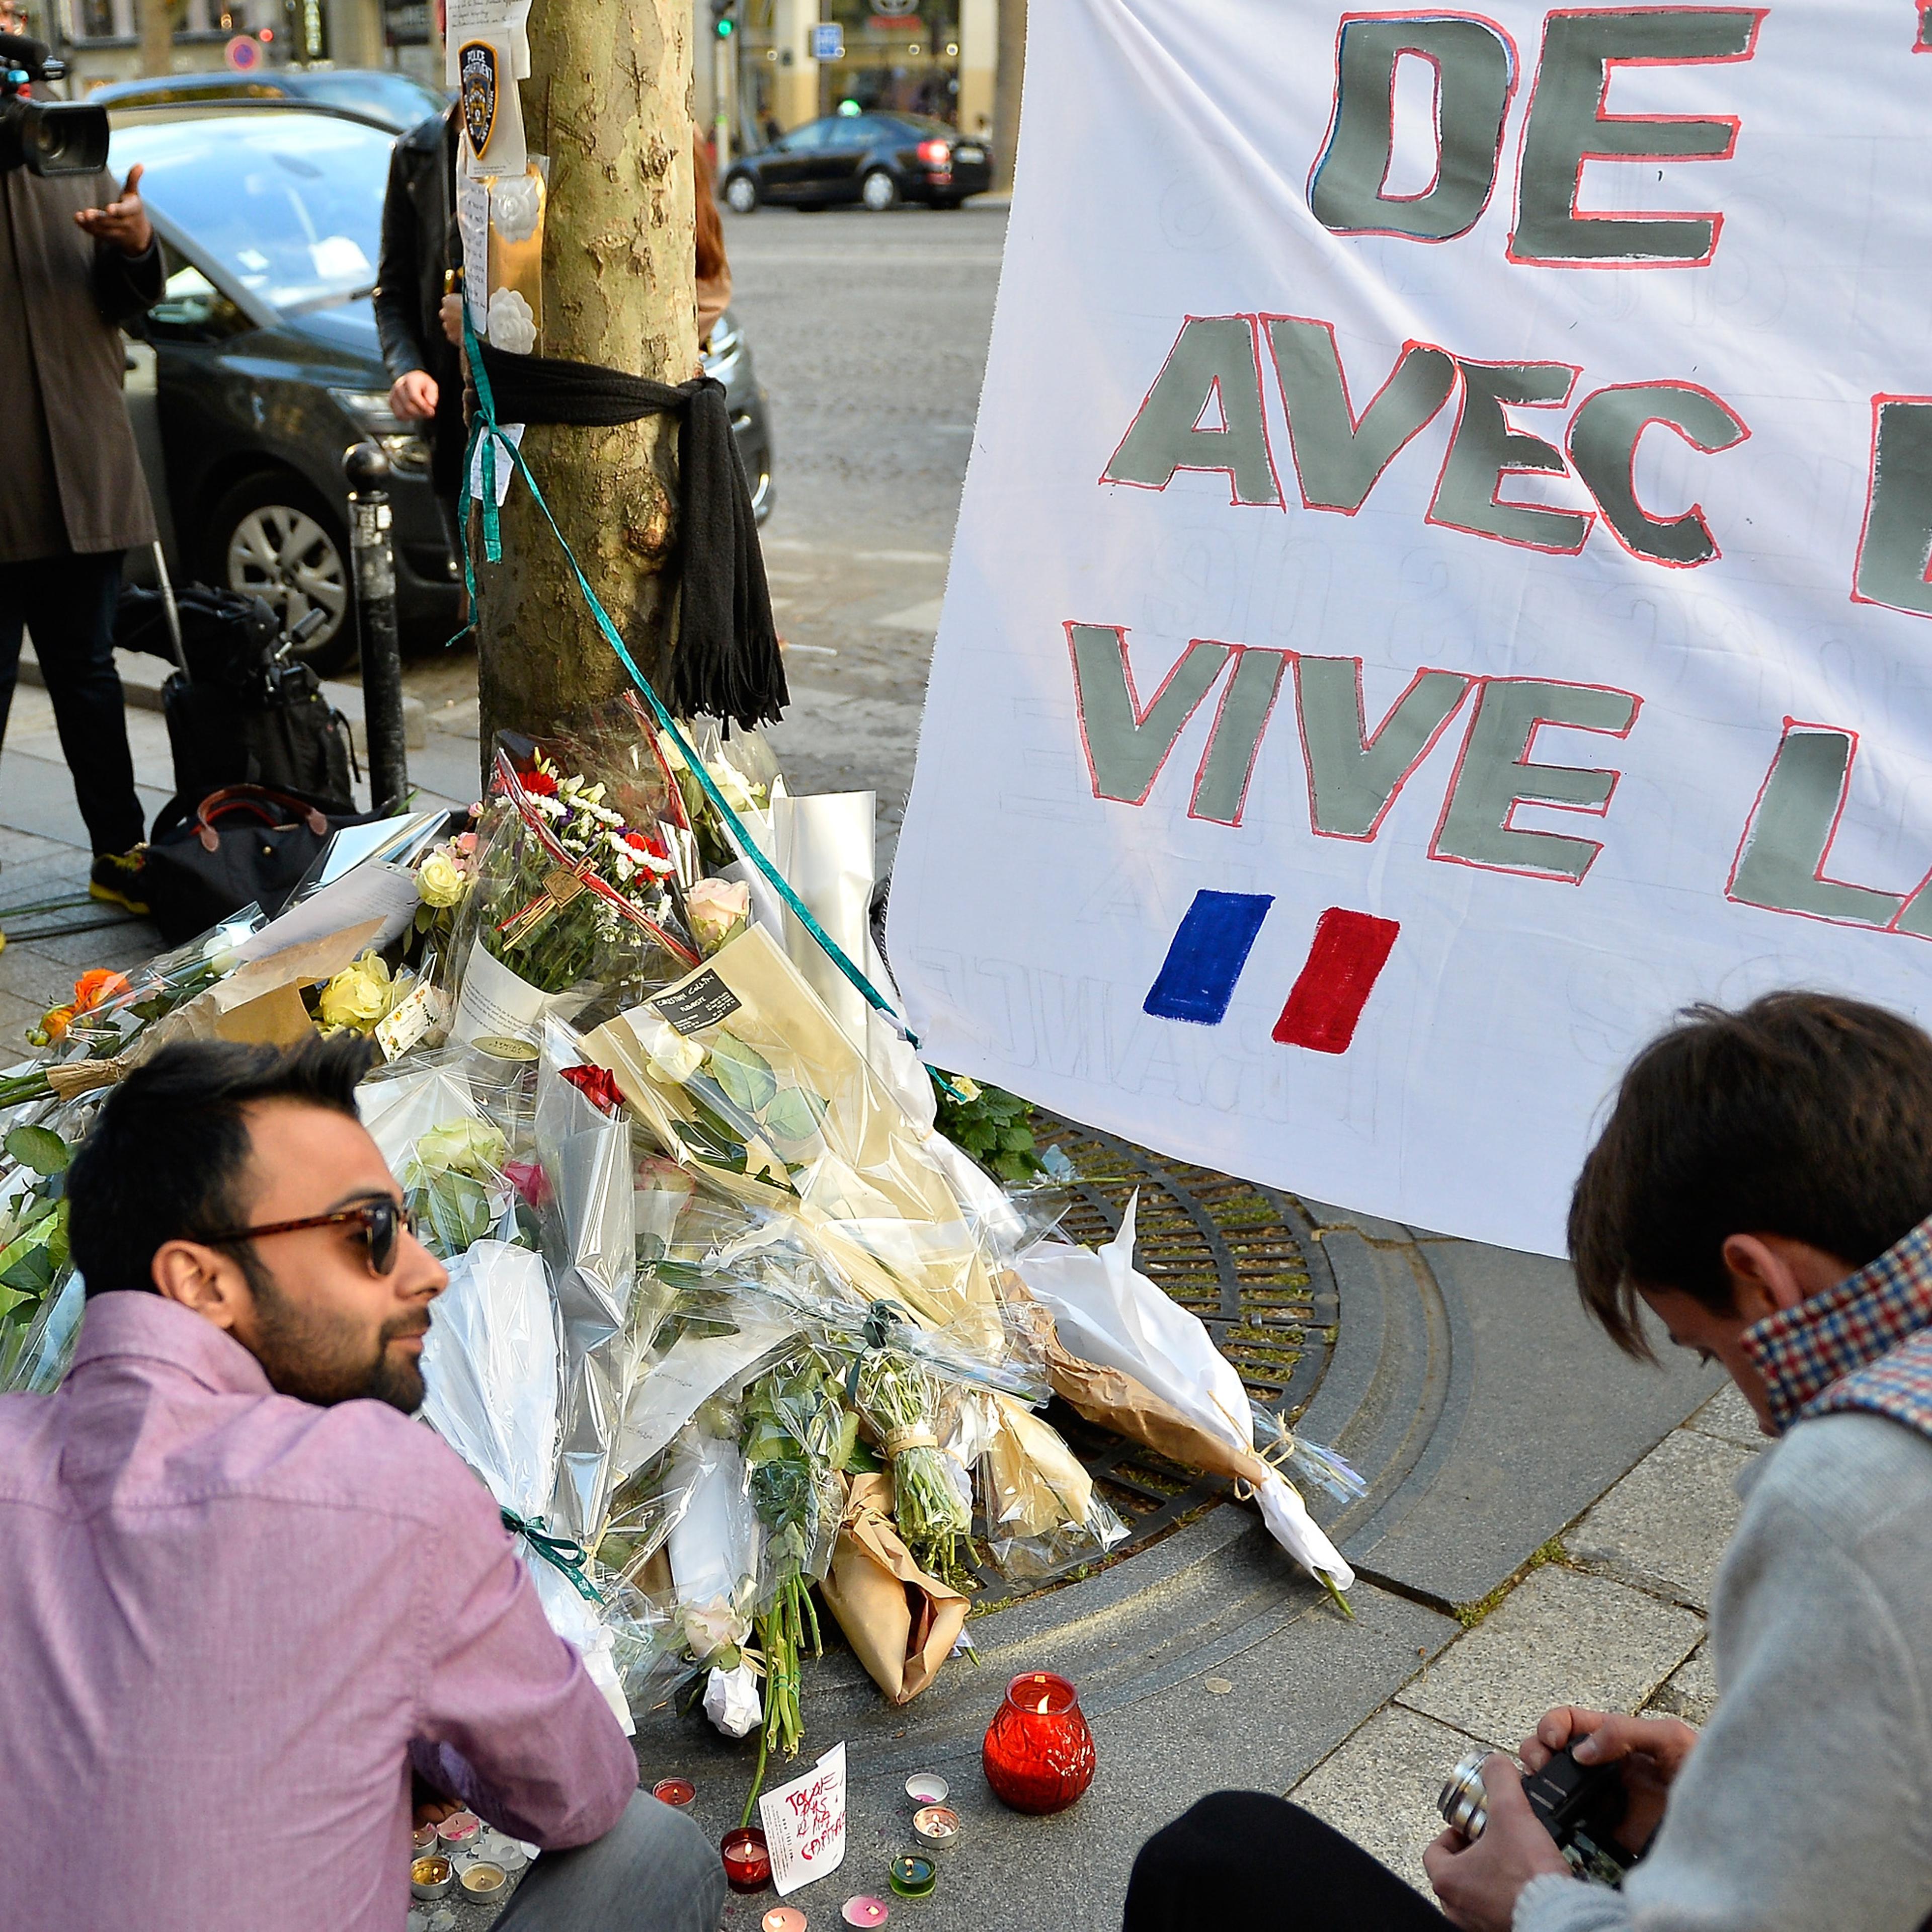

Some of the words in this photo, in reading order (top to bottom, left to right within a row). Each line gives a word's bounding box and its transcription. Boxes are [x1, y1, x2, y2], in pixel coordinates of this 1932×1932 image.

[1305, 6, 1771, 271] DE
[1098, 312, 1751, 569] AVEC
[1062, 620, 1645, 887] VIVE
